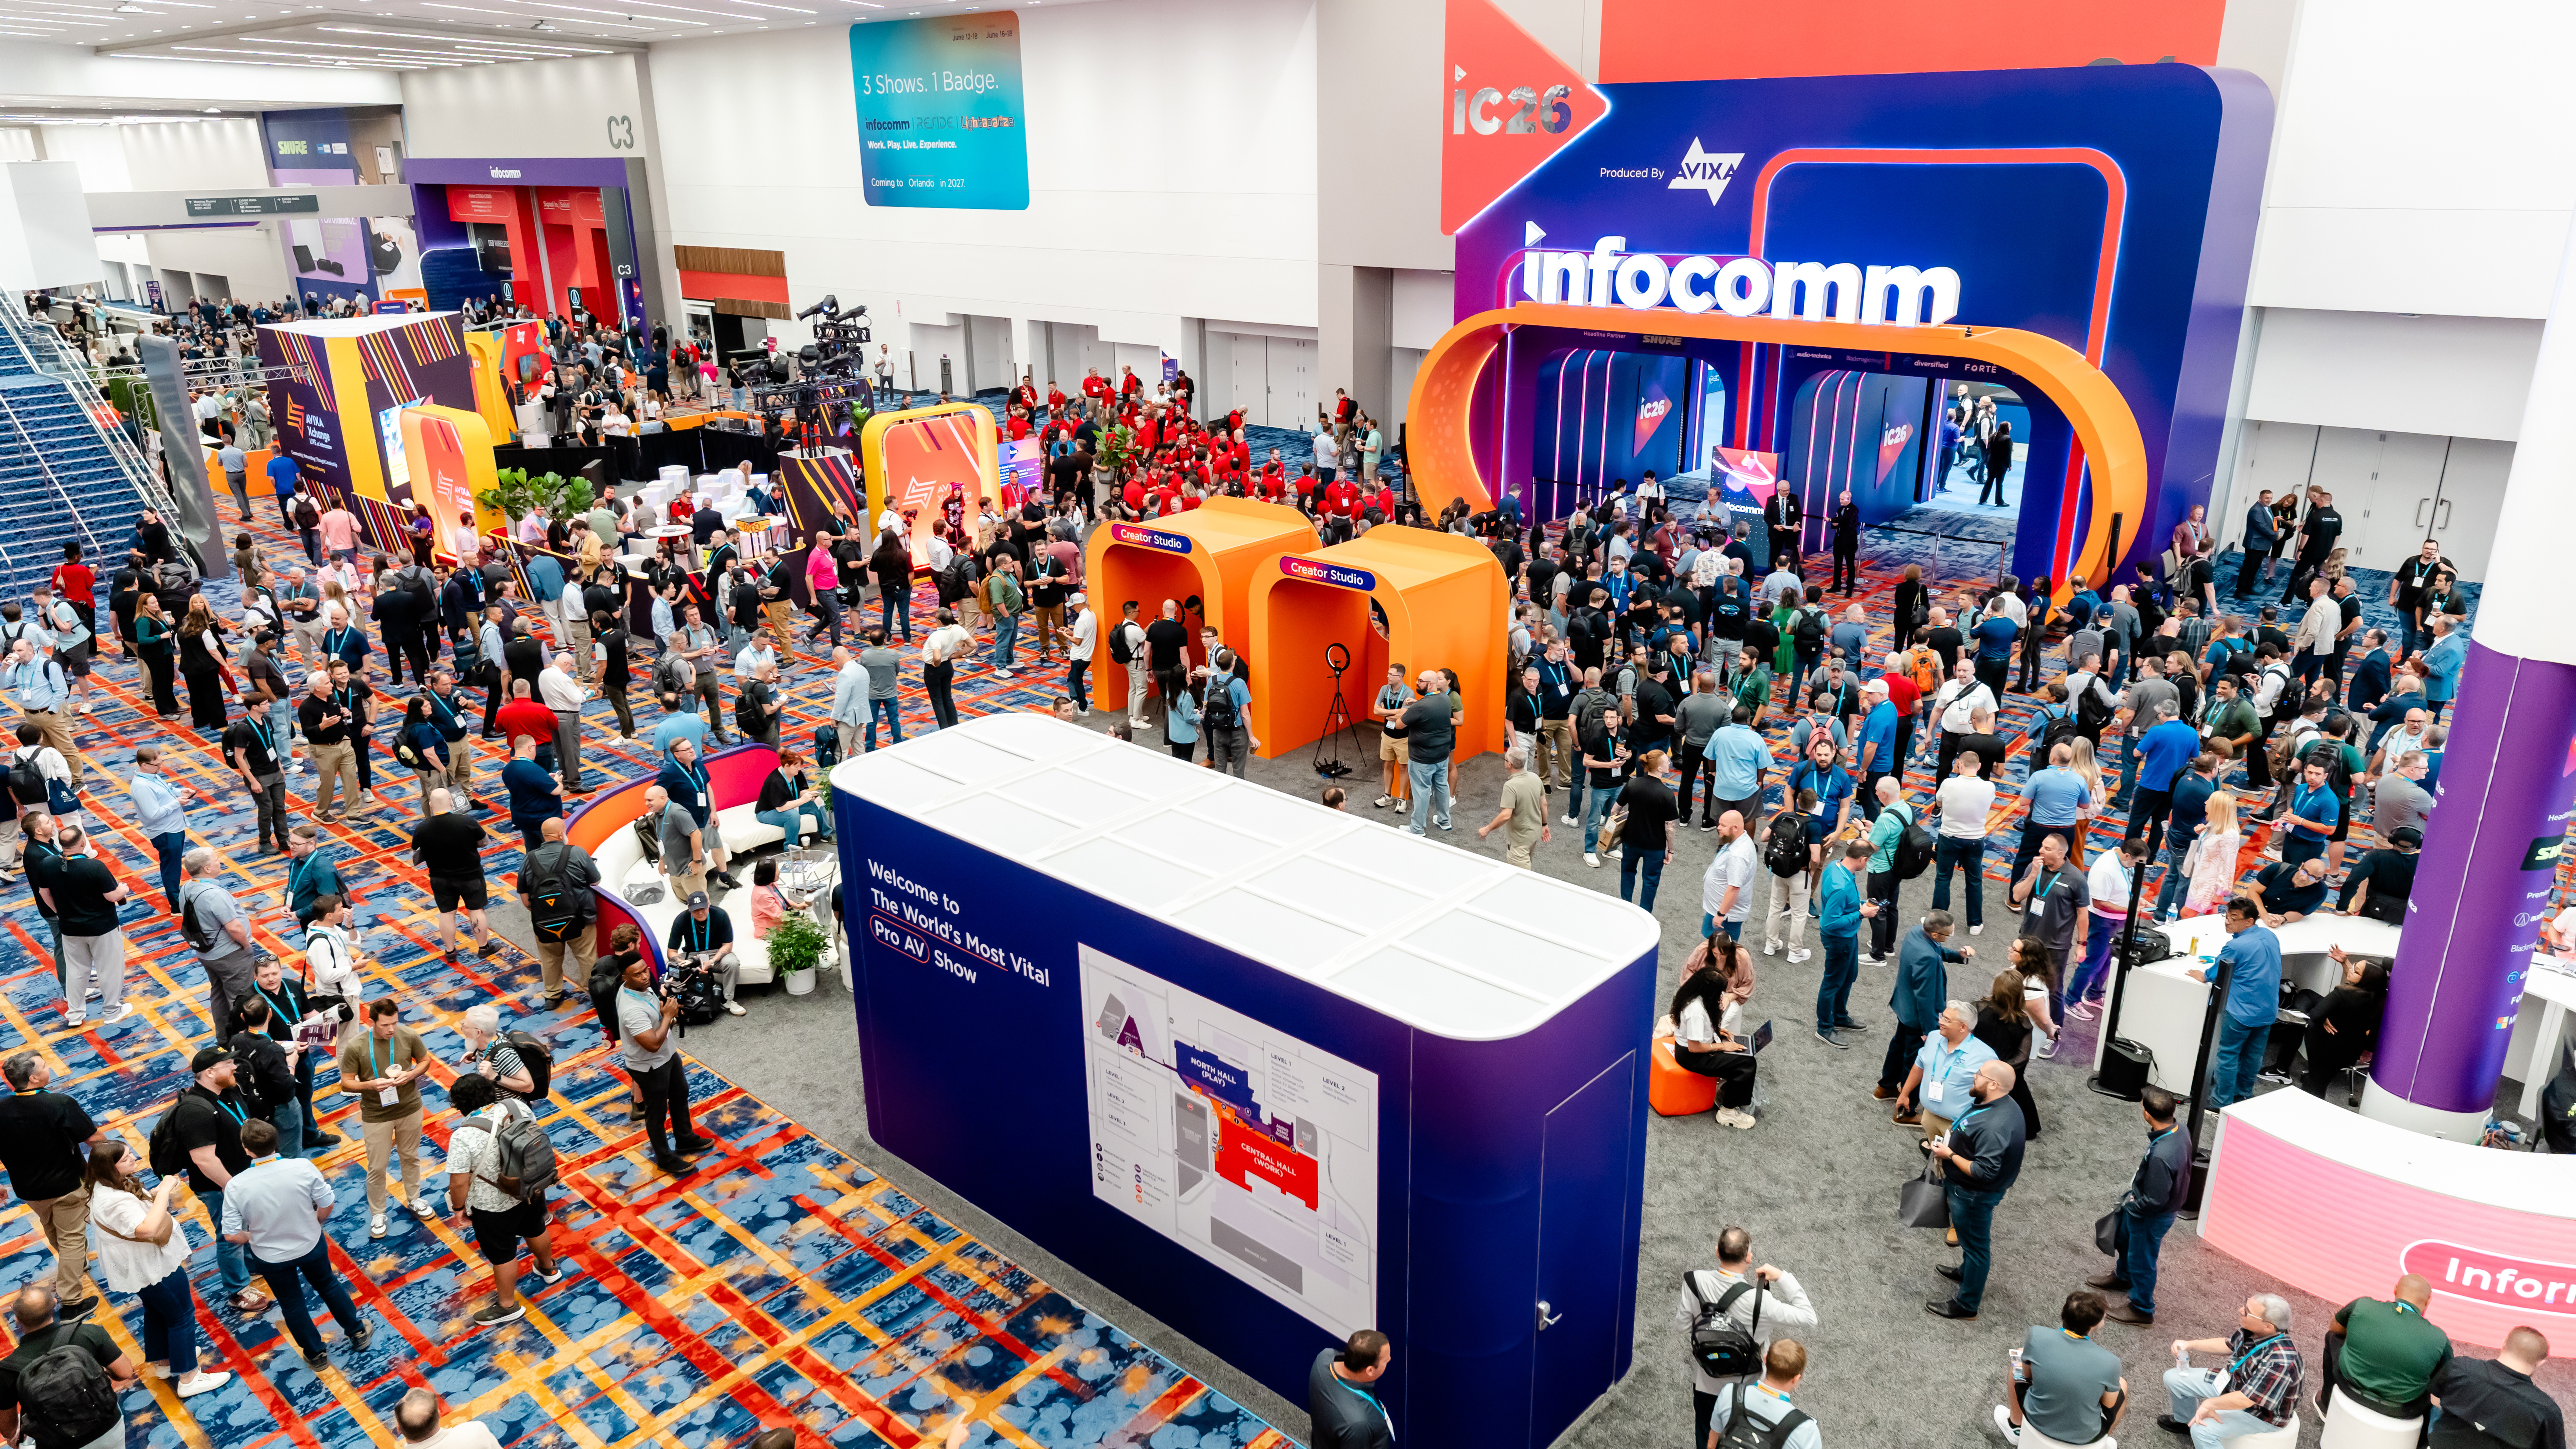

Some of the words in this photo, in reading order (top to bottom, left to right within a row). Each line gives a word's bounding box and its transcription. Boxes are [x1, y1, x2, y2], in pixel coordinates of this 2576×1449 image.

[862, 76, 871, 94] 3
[876, 74, 928, 94] Shows.
[932, 72, 937, 92] 1
[943, 69, 998, 94] Badge.
[1454, 64, 1572, 135] ic26
[865, 117, 910, 131] infocomm
[607, 115, 634, 149] C3
[278, 140, 308, 155] SHURE
[868, 140, 886, 149] Work.
[887, 140, 902, 150] Play.
[903, 140, 918, 149] Live.
[919, 139, 957, 150] Experience.
[490, 166, 521, 178] infocomm
[1600, 168, 1648, 178] Produced
[1651, 168, 1665, 181] By
[1675, 163, 1736, 180] AVIXA
[871, 178, 895, 188] Coming
[896, 179, 903, 187] to
[908, 178, 935, 188] Orlando
[940, 179, 946, 187] in
[948, 179, 965, 188] 2027.
[618, 264, 632, 275] C3
[1523, 221, 1961, 327] infocomm
[1643, 335, 1682, 346] SHURE
[1914, 360, 1949, 368] diversified
[1965, 364, 1997, 373] FORTÉ
[1640, 396, 1665, 420] ic26
[306, 414, 324, 428] AVIXA
[307, 425, 330, 443] Xchange
[1883, 422, 1907, 447] ic26
[454, 486, 471, 497] AVIXA
[937, 481, 965, 493] AVIA
[1121, 529, 1152, 543] Creator
[1154, 535, 1182, 549] Studio
[1291, 562, 1328, 578] Creator
[1331, 569, 1364, 585] Studio
[868, 859, 938, 905] Welcome
[943, 893, 960, 915] to
[871, 887, 898, 914] The
[902, 902, 961, 945] World's
[966, 932, 1005, 966] Most
[1010, 953, 1049, 987] Vital
[875, 920, 899, 945] Pro
[905, 936, 924, 957] AV
[934, 949, 976, 984] Show
[1271, 1053, 1287, 1065] LEVEL
[1106, 1069, 1120, 1080] LEVEL
[1191, 1057, 1215, 1074] NORTH
[1218, 1069, 1236, 1084] HALL
[1202, 1070, 1225, 1087] (PLAY)
[1323, 1077, 1340, 1089] LEVEL
[1107, 1091, 1121, 1102] LEVEL
[1108, 1113, 1122, 1124] LEVEL
[1276, 1124, 1289, 1133] AUDIO
[1277, 1128, 1288, 1137] DEMO
[1275, 1131, 1290, 1141] ROOMS
[1241, 1142, 1275, 1166] CENTRAL
[1277, 1160, 1296, 1177] HALL
[1254, 1157, 1283, 1178] (WORK)
[1326, 1232, 1342, 1245] LEVEL
[2445, 1257, 2576, 1305] Infor
